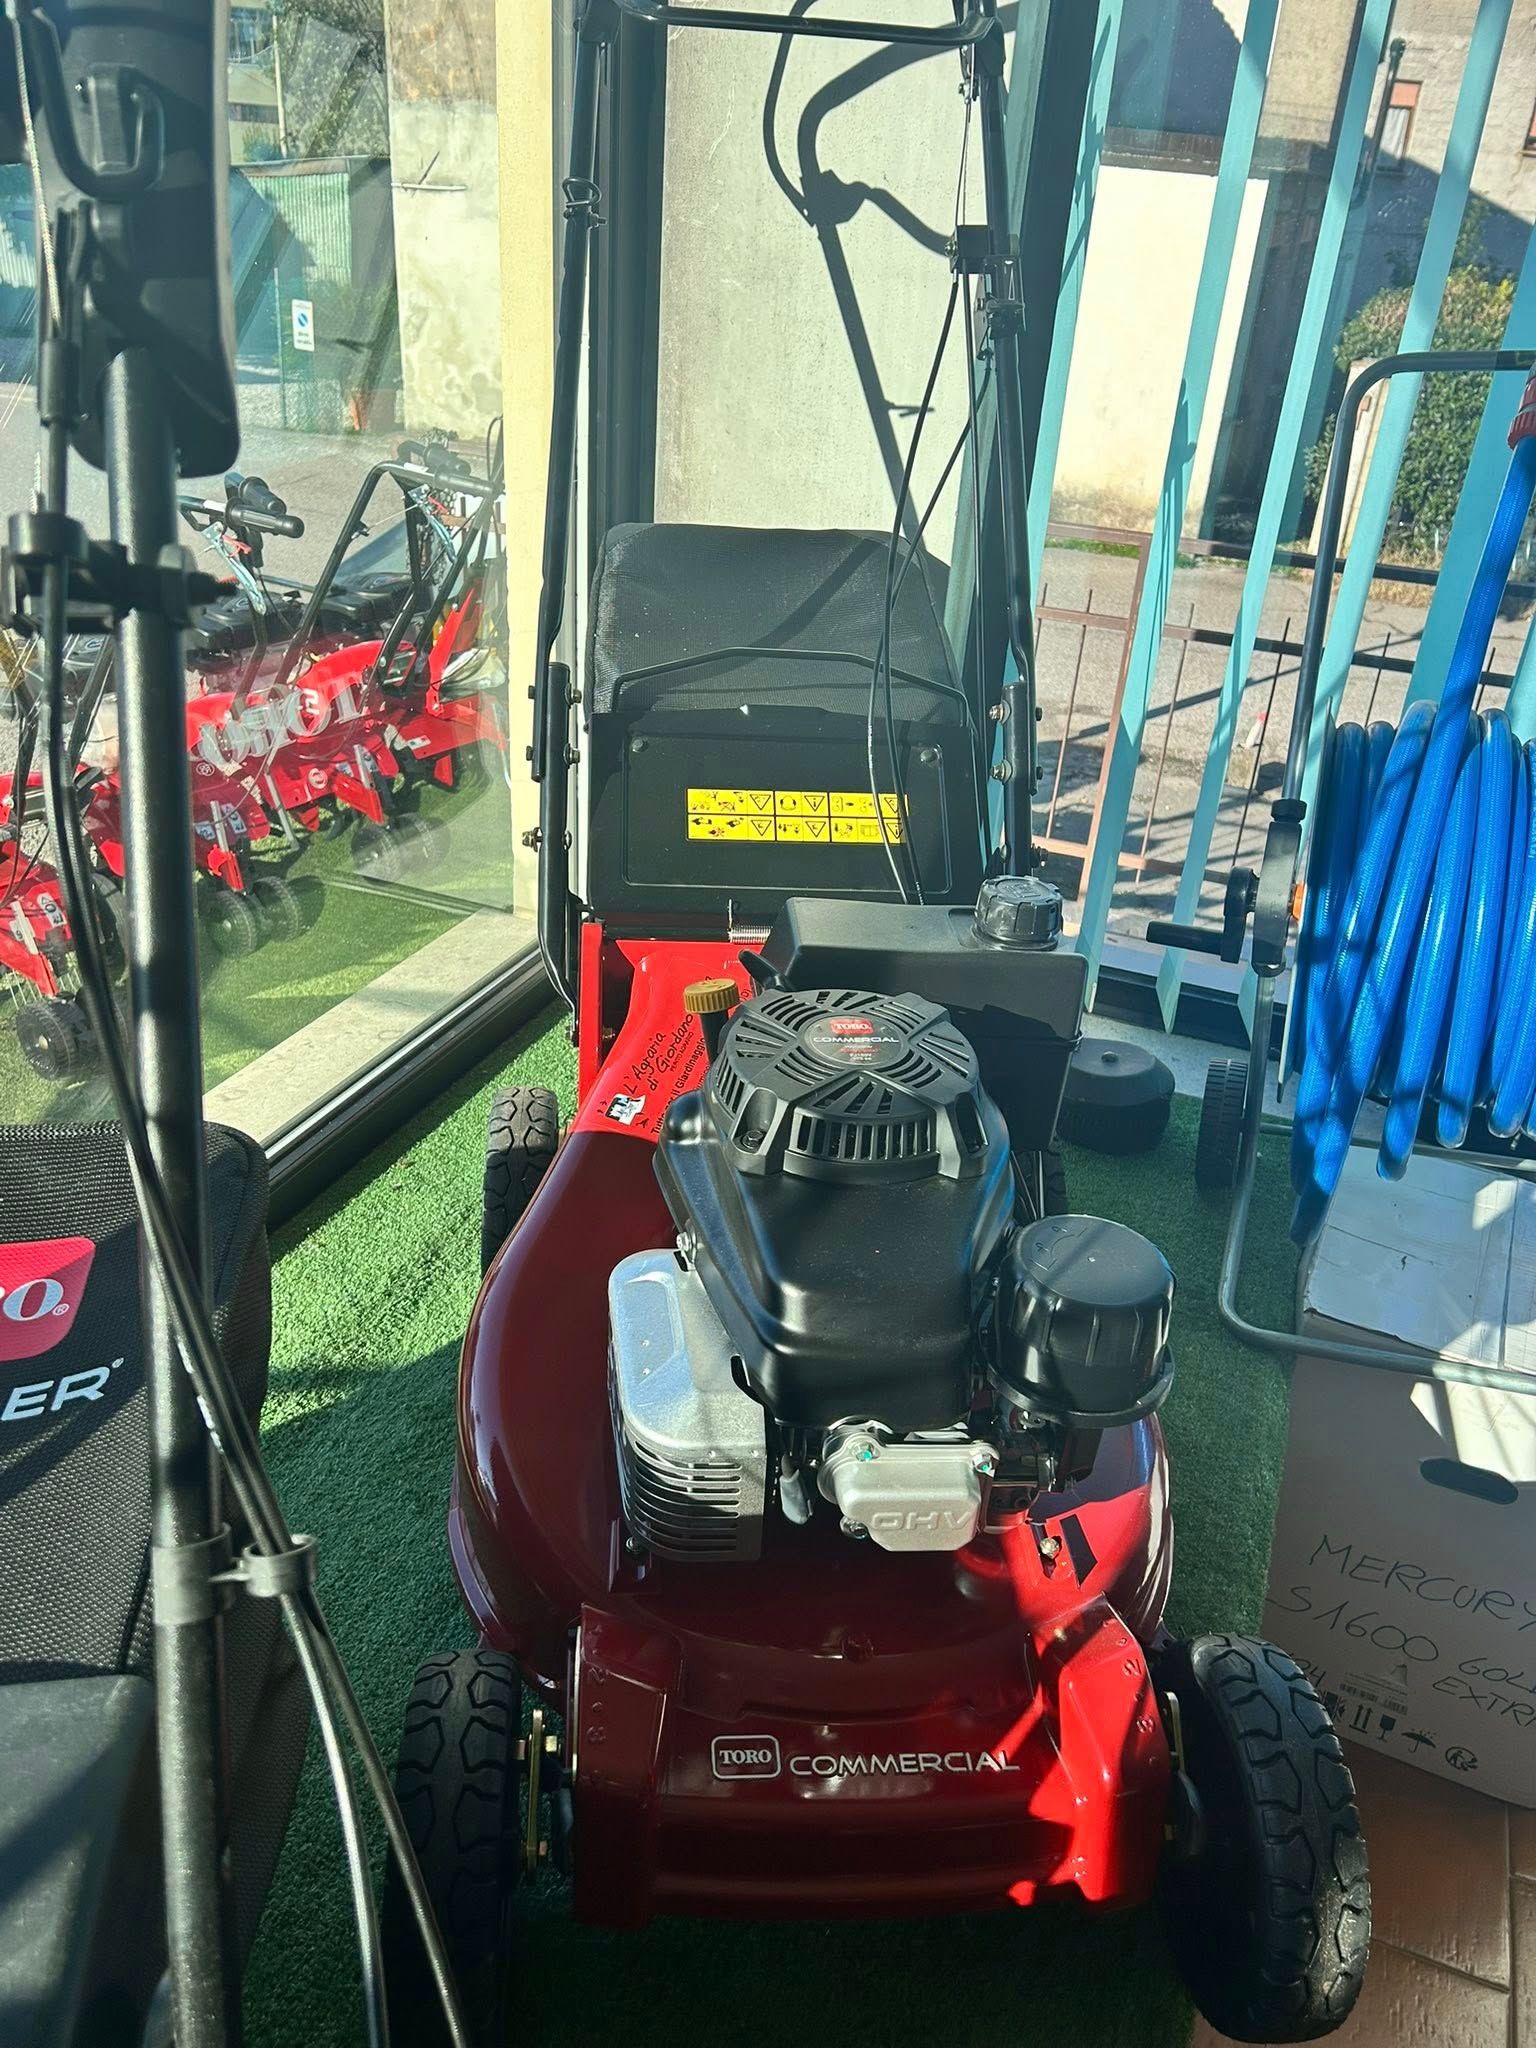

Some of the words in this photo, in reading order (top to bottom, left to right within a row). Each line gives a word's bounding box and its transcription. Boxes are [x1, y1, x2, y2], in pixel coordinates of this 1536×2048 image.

[656, 1014, 694, 1073] Giordano
[872, 1512, 973, 1530] OHV
[719, 1749, 772, 1764] TORO
[789, 1750, 1021, 1776] COMMERCIAL
